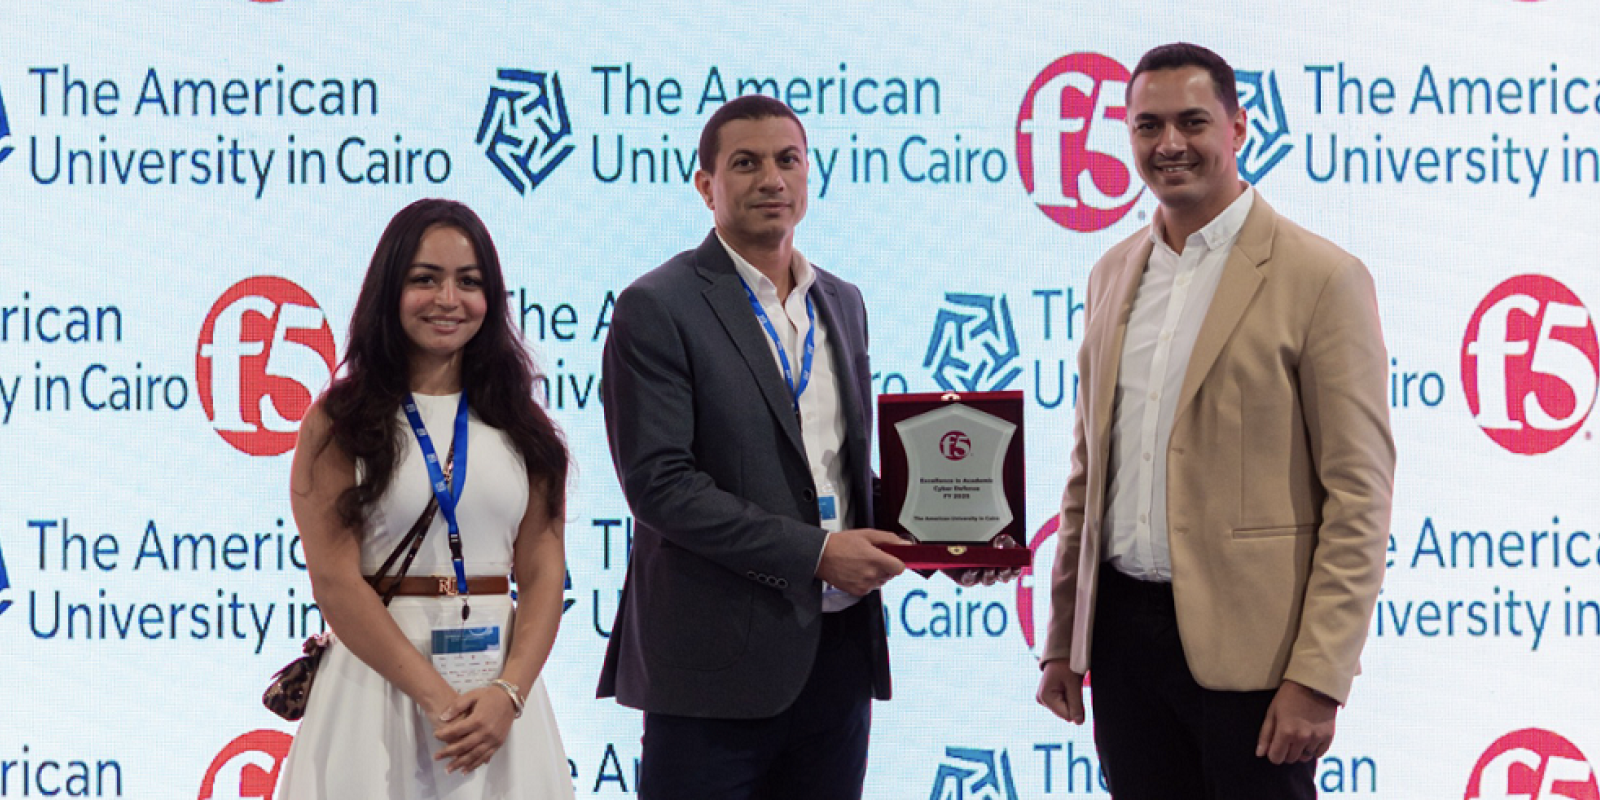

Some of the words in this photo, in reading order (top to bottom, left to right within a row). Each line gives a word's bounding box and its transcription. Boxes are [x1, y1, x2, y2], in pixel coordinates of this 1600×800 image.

[29, 64, 120, 116] The
[135, 65, 378, 116] American
[591, 62, 682, 116] The
[1304, 62, 1395, 114] The
[31, 135, 275, 199] University
[288, 135, 325, 184] in
[337, 134, 451, 184] Cairo
[850, 133, 888, 183] in
[899, 134, 1008, 184] Cairo
[1306, 134, 1548, 198] University
[1563, 132, 1600, 182] in
[35, 361, 70, 411] in
[81, 362, 188, 411] Cairo
[201, 294, 333, 433] f5
[1468, 294, 1597, 431] f5
[942, 434, 971, 457] f5
[27, 518, 119, 571] The
[29, 589, 275, 654] University
[288, 588, 325, 638] in
[901, 588, 1008, 637] Cairo
[1564, 586, 1600, 636] in
